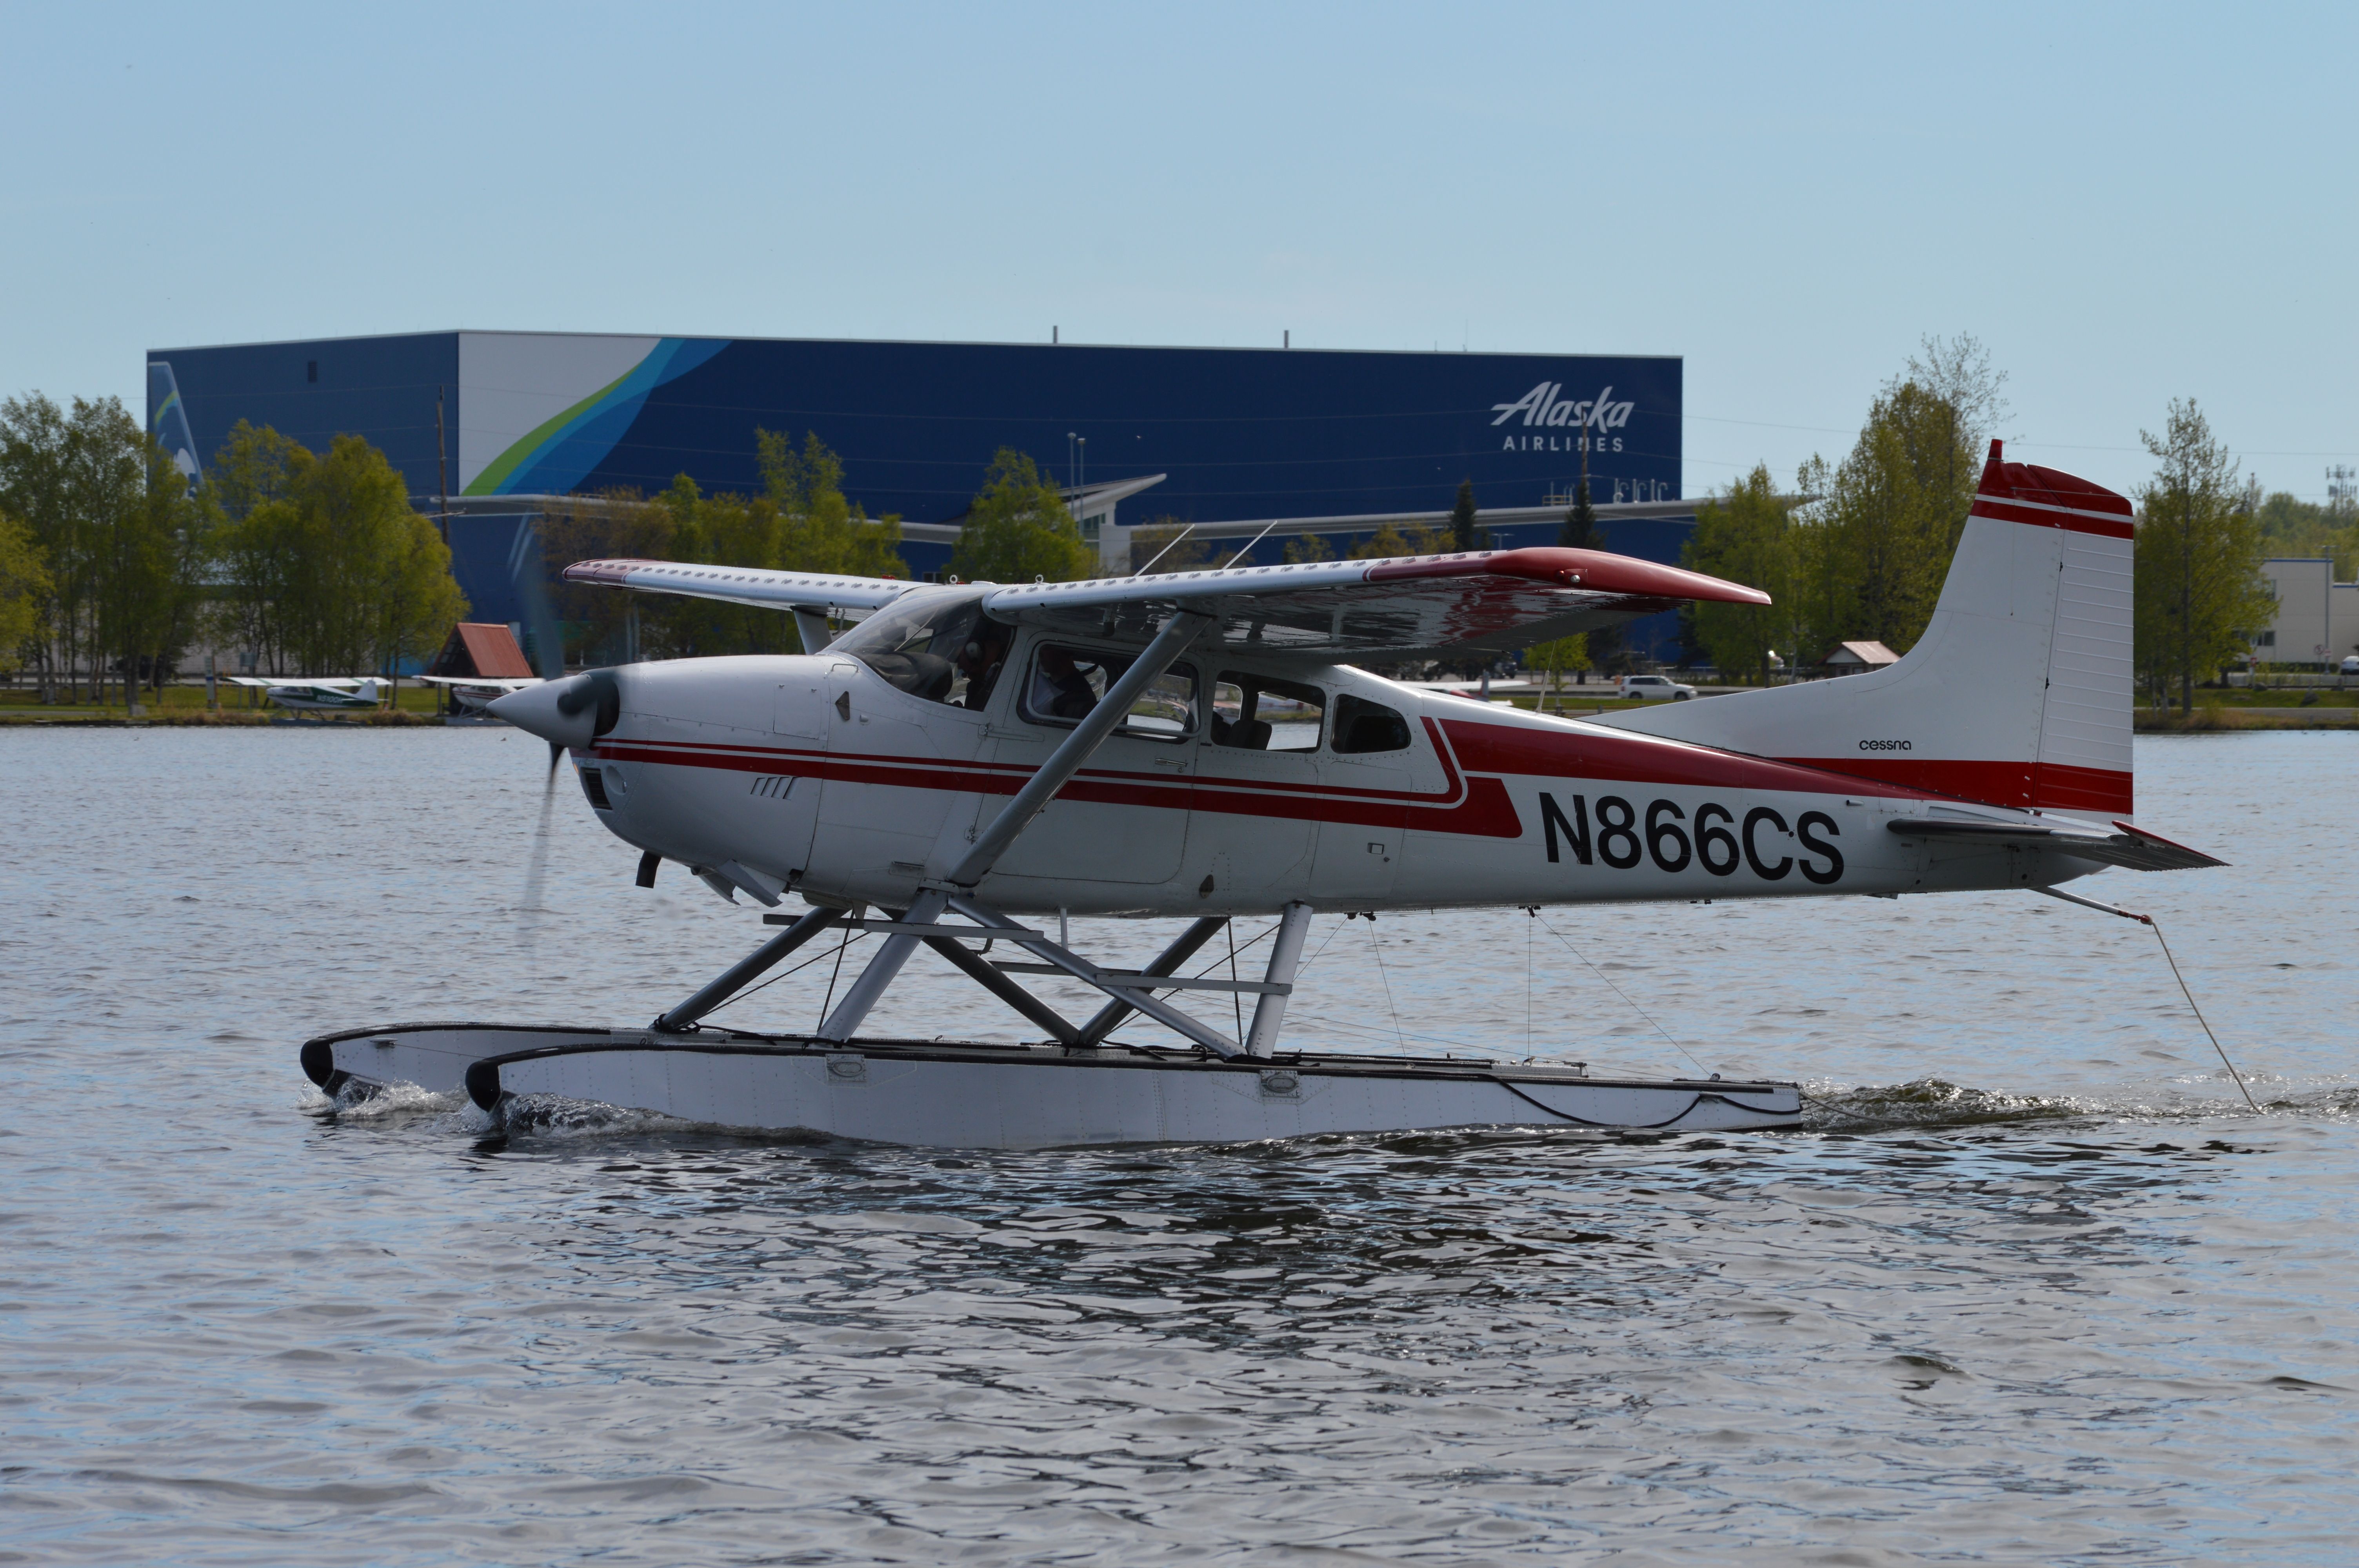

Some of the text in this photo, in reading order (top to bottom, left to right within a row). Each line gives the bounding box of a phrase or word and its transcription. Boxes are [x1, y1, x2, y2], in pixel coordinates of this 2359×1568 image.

[1491, 381, 1634, 434] Alaska
[1503, 436, 1623, 452] AIRLINES
[1859, 740, 1912, 750] cessna
[1539, 792, 1844, 885] N866CS
